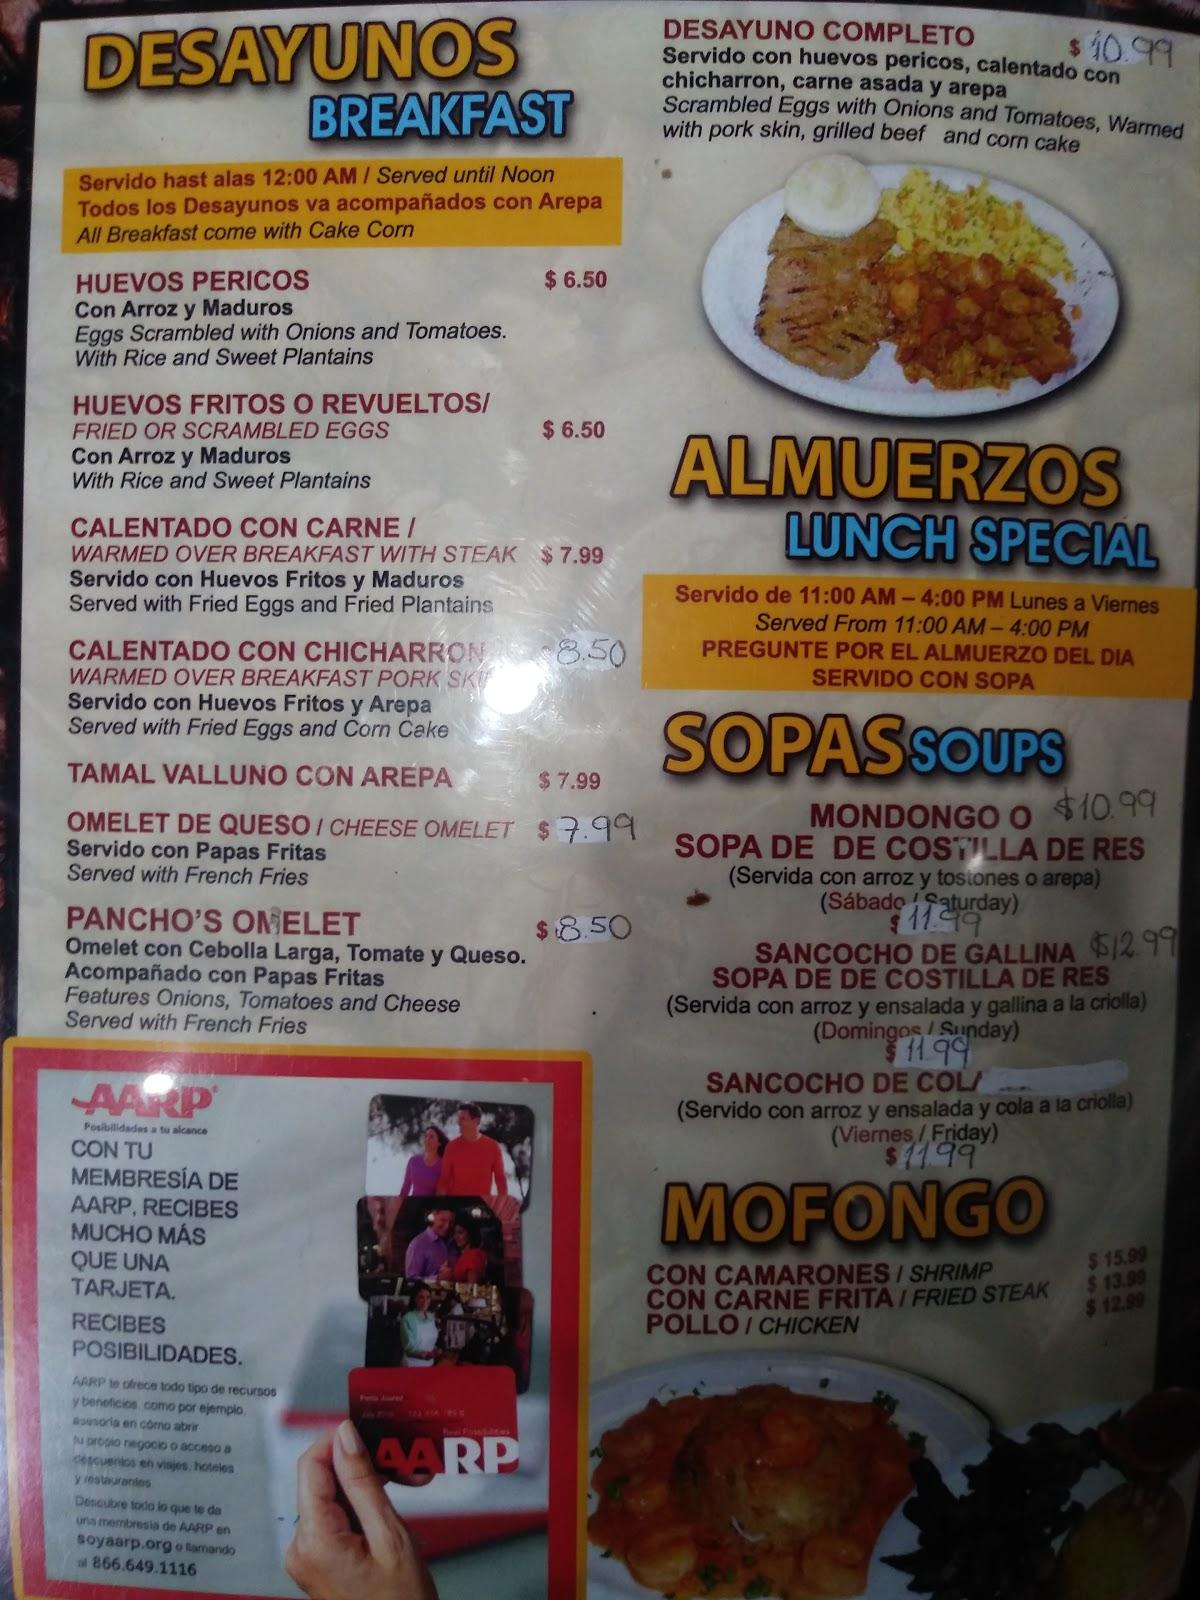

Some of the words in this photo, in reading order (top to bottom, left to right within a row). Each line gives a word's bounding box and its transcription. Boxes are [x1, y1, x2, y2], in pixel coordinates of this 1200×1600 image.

[664, 18, 815, 41] DESAYUNO
[823, 21, 975, 48] COMPLETO
[82, 16, 519, 93] DESAYUNOS
[662, 71, 786, 93] chicharron,
[792, 75, 853, 90] carne
[859, 77, 923, 93] asada
[929, 80, 943, 99] y
[948, 81, 1007, 101] arepa
[308, 89, 574, 142] BREAKFAST
[79, 172, 157, 192] Servido
[163, 171, 208, 189] hast
[213, 170, 256, 188] alas
[263, 167, 318, 186] 12:00
[322, 167, 357, 185] AM
[376, 165, 449, 185] Served
[453, 165, 496, 184] until
[500, 165, 555, 183] Noon
[78, 199, 140, 218] Todos
[146, 198, 177, 216] los
[183, 197, 299, 217] Desayunos
[305, 198, 330, 212] va
[336, 192, 486, 215] acompañados
[493, 196, 533, 210] con
[538, 191, 602, 213] Arepa
[76, 271, 184, 295] HUEVOS
[192, 269, 310, 292] PERICOS
[544, 269, 557, 291] $
[563, 270, 608, 289] 6.50
[73, 393, 182, 416] HUEVOS
[190, 393, 285, 415] FRITOS
[293, 393, 314, 415] O
[322, 392, 491, 415] REVUELTOS/
[72, 422, 138, 440] FRIED
[144, 421, 177, 440] OR
[182, 421, 320, 440] SCRAMBLED
[325, 421, 390, 440] EGGS
[542, 419, 555, 441] $
[561, 420, 606, 439] 6.50
[670, 434, 1122, 508] ALMUERZOS
[71, 517, 232, 538] CALENTADO
[240, 516, 298, 539] CON
[306, 517, 400, 539] CARNE
[785, 511, 960, 562] LUNCH
[970, 517, 1159, 571] SPECIAL
[541, 545, 553, 566] $
[560, 546, 604, 565] 7.99
[68, 639, 231, 662] CALENTADO
[238, 640, 295, 662] CON
[556, 638, 626, 668] 8.50
[702, 639, 828, 659] PREGUNTE
[835, 641, 884, 661] POR
[891, 642, 919, 661] EL
[923, 643, 1048, 664] ALMUERZO
[1054, 646, 1095, 666] DEL
[1101, 648, 1135, 667] DIA
[812, 668, 914, 689] SERVIDO
[919, 670, 968, 689] CON
[975, 671, 1035, 690] SOPA
[662, 711, 908, 777] SOPAS
[908, 726, 1066, 776] SOUPS
[67, 762, 156, 784] TAMAL
[162, 763, 288, 786] VALLUNO
[295, 764, 353, 787] CON
[360, 766, 453, 788] AREPA
[539, 770, 551, 791] $
[558, 771, 601, 791] 7.99
[67, 811, 171, 834] OMELET
[178, 813, 211, 834] DE
[219, 814, 311, 836] QUESO
[330, 818, 418, 838] CHEESE
[424, 819, 515, 839] OMELET
[560, 812, 636, 844] 7.99
[810, 803, 1000, 830] MONDONGO
[1009, 805, 1032, 830] O
[820, 892, 906, 916] (Sábado
[232, 909, 361, 937] OMELET
[560, 914, 632, 942] 8.50
[755, 943, 913, 965] SANCOCHO
[921, 943, 957, 965] DE
[964, 942, 1076, 965] GALLINA
[813, 1020, 924, 1043] (Domingos
[706, 1072, 865, 1095] SANCOCHO
[873, 1072, 909, 1094] DE
[84, 1122, 148, 1134] Posibilidades
[160, 1125, 171, 1134] tu
[172, 1125, 208, 1136] alcance
[831, 1125, 916, 1148] (Viernes
[931, 1123, 999, 1147] Friday)
[71, 1139, 118, 1159] CON
[124, 1141, 153, 1161] TU
[71, 1167, 204, 1190] MEMBRESÍA
[208, 1171, 239, 1191] DE
[70, 1195, 136, 1217] AARP,
[143, 1197, 239, 1220] RECIBES
[661, 1176, 1048, 1245] MOFONGO
[71, 1223, 153, 1244] MUCHO
[158, 1224, 206, 1246] MÁS
[71, 1250, 118, 1272] QUE
[123, 1252, 170, 1273] UNA
[646, 1263, 706, 1286] CON
[715, 1262, 890, 1286] CAMARONES
[909, 1261, 993, 1284] SHRIMP
[71, 1277, 176, 1301] TARJETA.
[646, 1288, 706, 1311] CON
[714, 1288, 810, 1311] CARNE
[818, 1286, 895, 1309] FRITA
[911, 1286, 977, 1307] FRIED
[982, 1281, 1050, 1304] STEAK
[72, 1312, 166, 1335] RECIBES
[646, 1313, 739, 1336] POLLO
[758, 1315, 860, 1336] CHICKEN
[73, 1340, 243, 1366] POSIBILIDADES.
[375, 1436, 520, 1475] AARP
[77, 1532, 173, 1554] soyaarp.org
[92, 1556, 197, 1577] 866.649.1116
